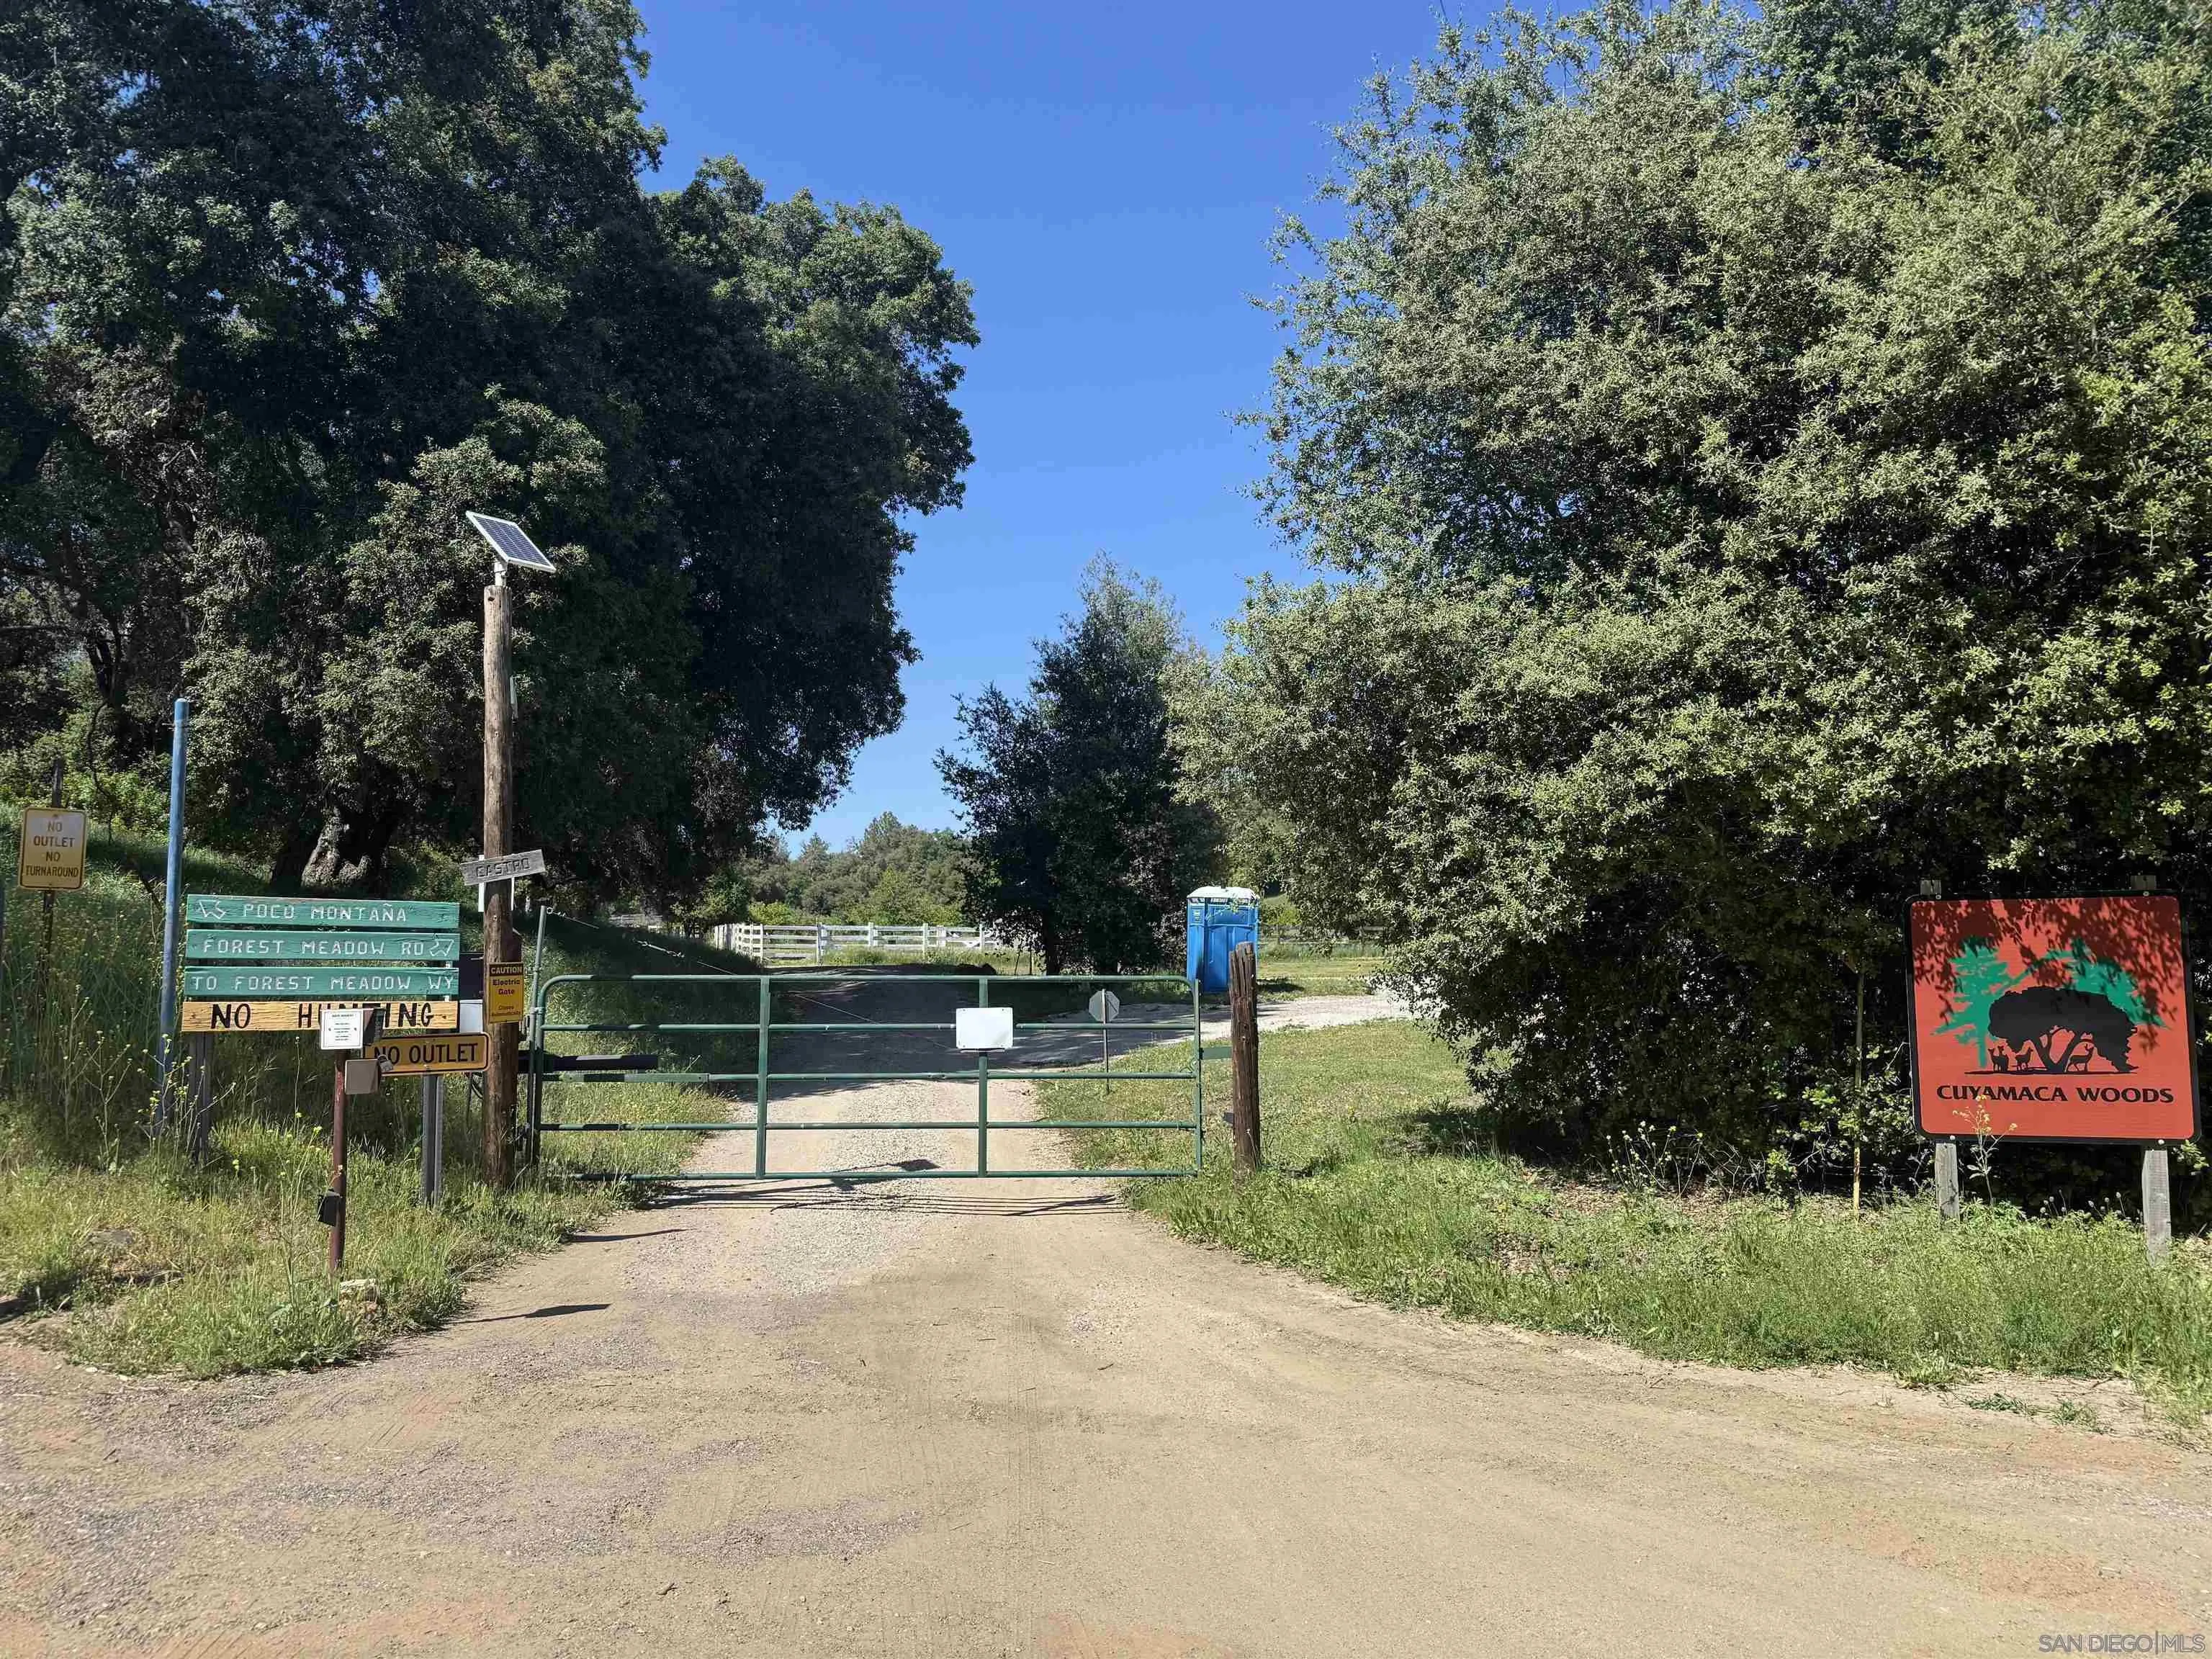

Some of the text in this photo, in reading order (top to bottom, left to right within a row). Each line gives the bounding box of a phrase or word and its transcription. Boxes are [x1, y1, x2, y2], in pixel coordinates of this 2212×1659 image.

[48, 822, 63, 832] NO
[33, 835, 75, 848] OUTLET
[45, 851, 60, 861] NO
[25, 866, 78, 878] TURNAROUND
[243, 903, 407, 922] POCO MONTAÑA
[204, 939, 423, 956] FOREST MEADOW RD
[192, 976, 454, 990] TO FOREST MEADOW WY
[211, 1002, 434, 1029] NO HING
[374, 1043, 478, 1065] NO OUTLET
[1936, 1084, 2174, 1103] CUYAMACA WOODS
